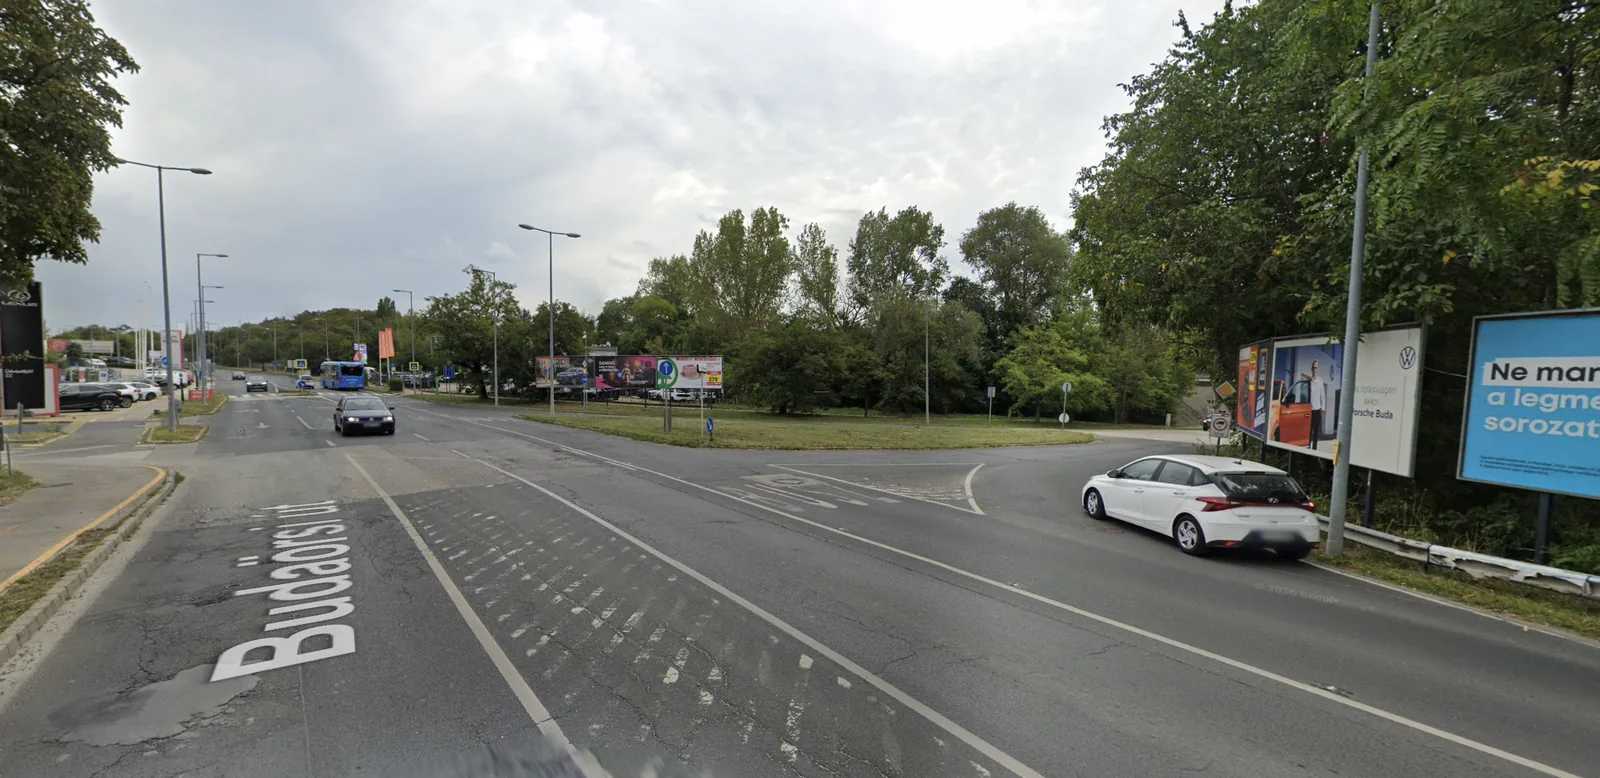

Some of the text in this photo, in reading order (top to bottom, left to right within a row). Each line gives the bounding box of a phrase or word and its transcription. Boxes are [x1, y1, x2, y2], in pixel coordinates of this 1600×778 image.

[1491, 363, 1528, 381] Ne
[1487, 392, 1506, 406] a
[1352, 408, 1393, 419] orsche Buda
[1484, 416, 1600, 438] sorozat
